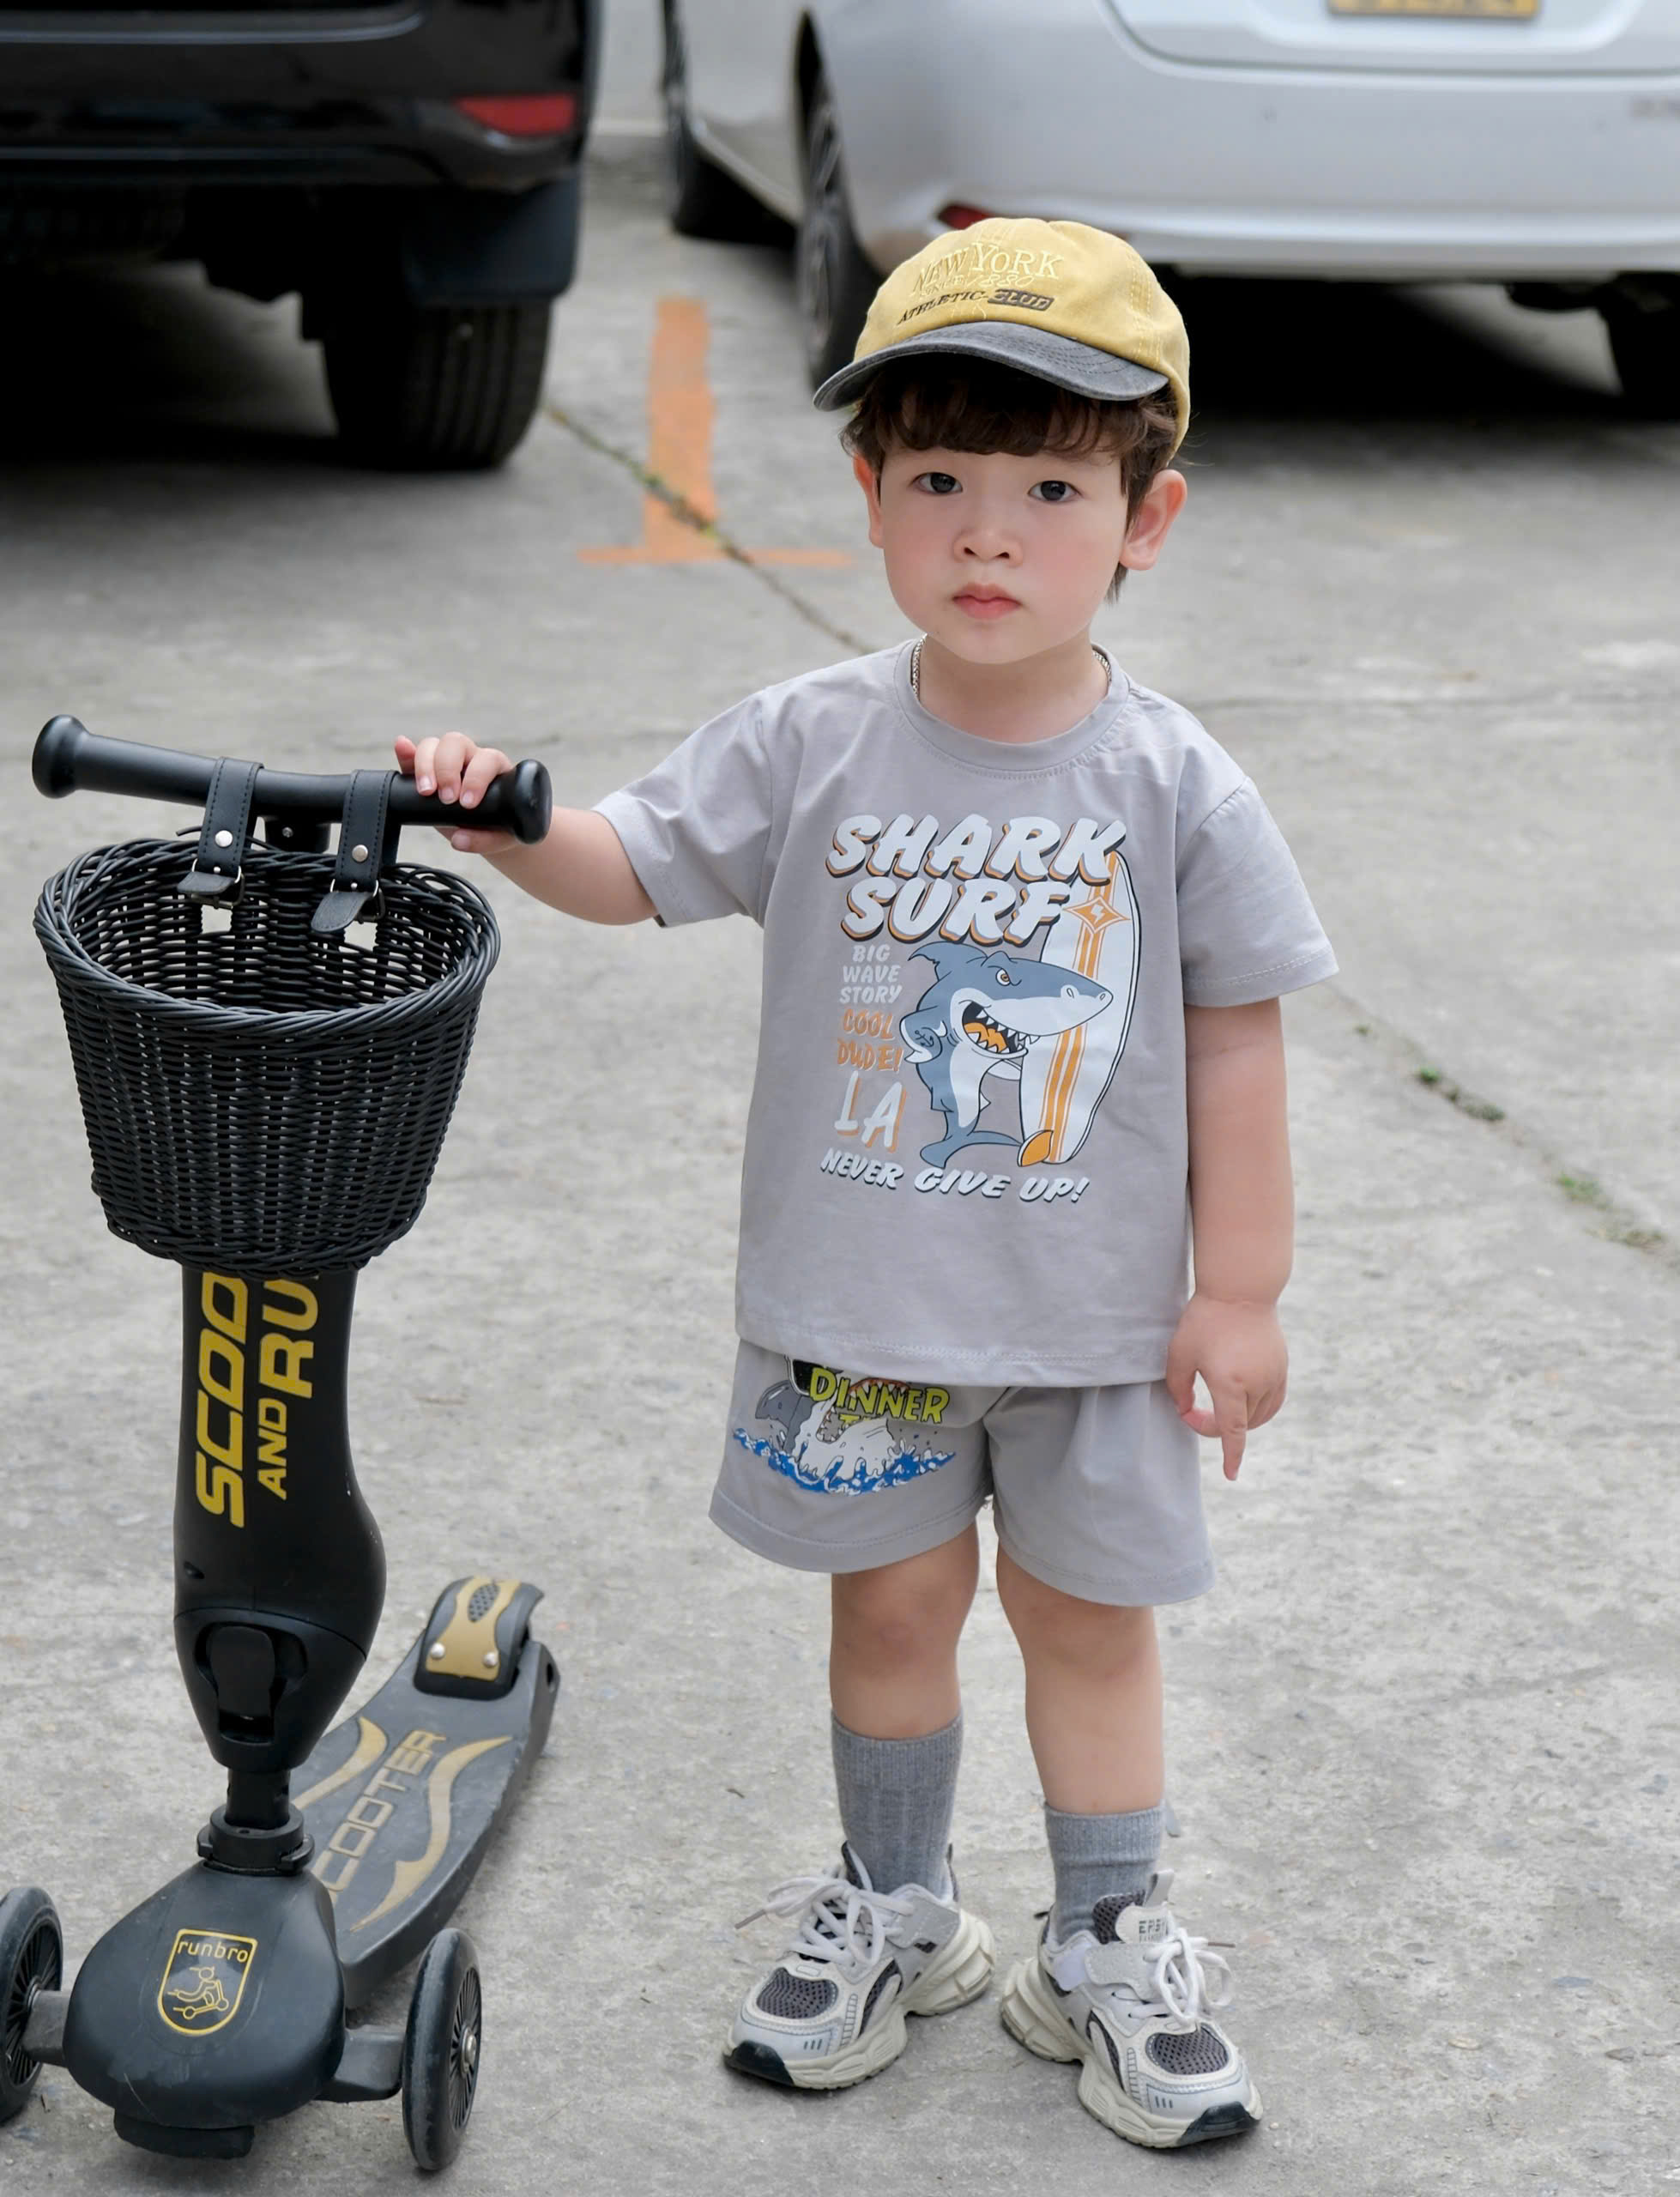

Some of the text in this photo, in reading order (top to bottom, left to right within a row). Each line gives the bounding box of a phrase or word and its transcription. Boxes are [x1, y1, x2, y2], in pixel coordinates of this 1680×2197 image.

[909, 241, 1064, 297] NEW YORK
[825, 813, 1126, 885] SHARK
[841, 877, 1070, 947] SURF
[843, 965, 901, 984] WAVE
[852, 944, 891, 962] BIG
[839, 985, 903, 1004] STORY
[843, 1008, 895, 1041] COOL
[837, 1038, 904, 1074] DUDE!
[834, 1070, 906, 1153] LA
[820, 1147, 1091, 1203] NEVER GIVE UP!
[809, 1365, 951, 1425] DINNER
[257, 1397, 287, 1501] AND
[311, 1729, 447, 1908] COOTER
[177, 1940, 249, 1963] runbro
